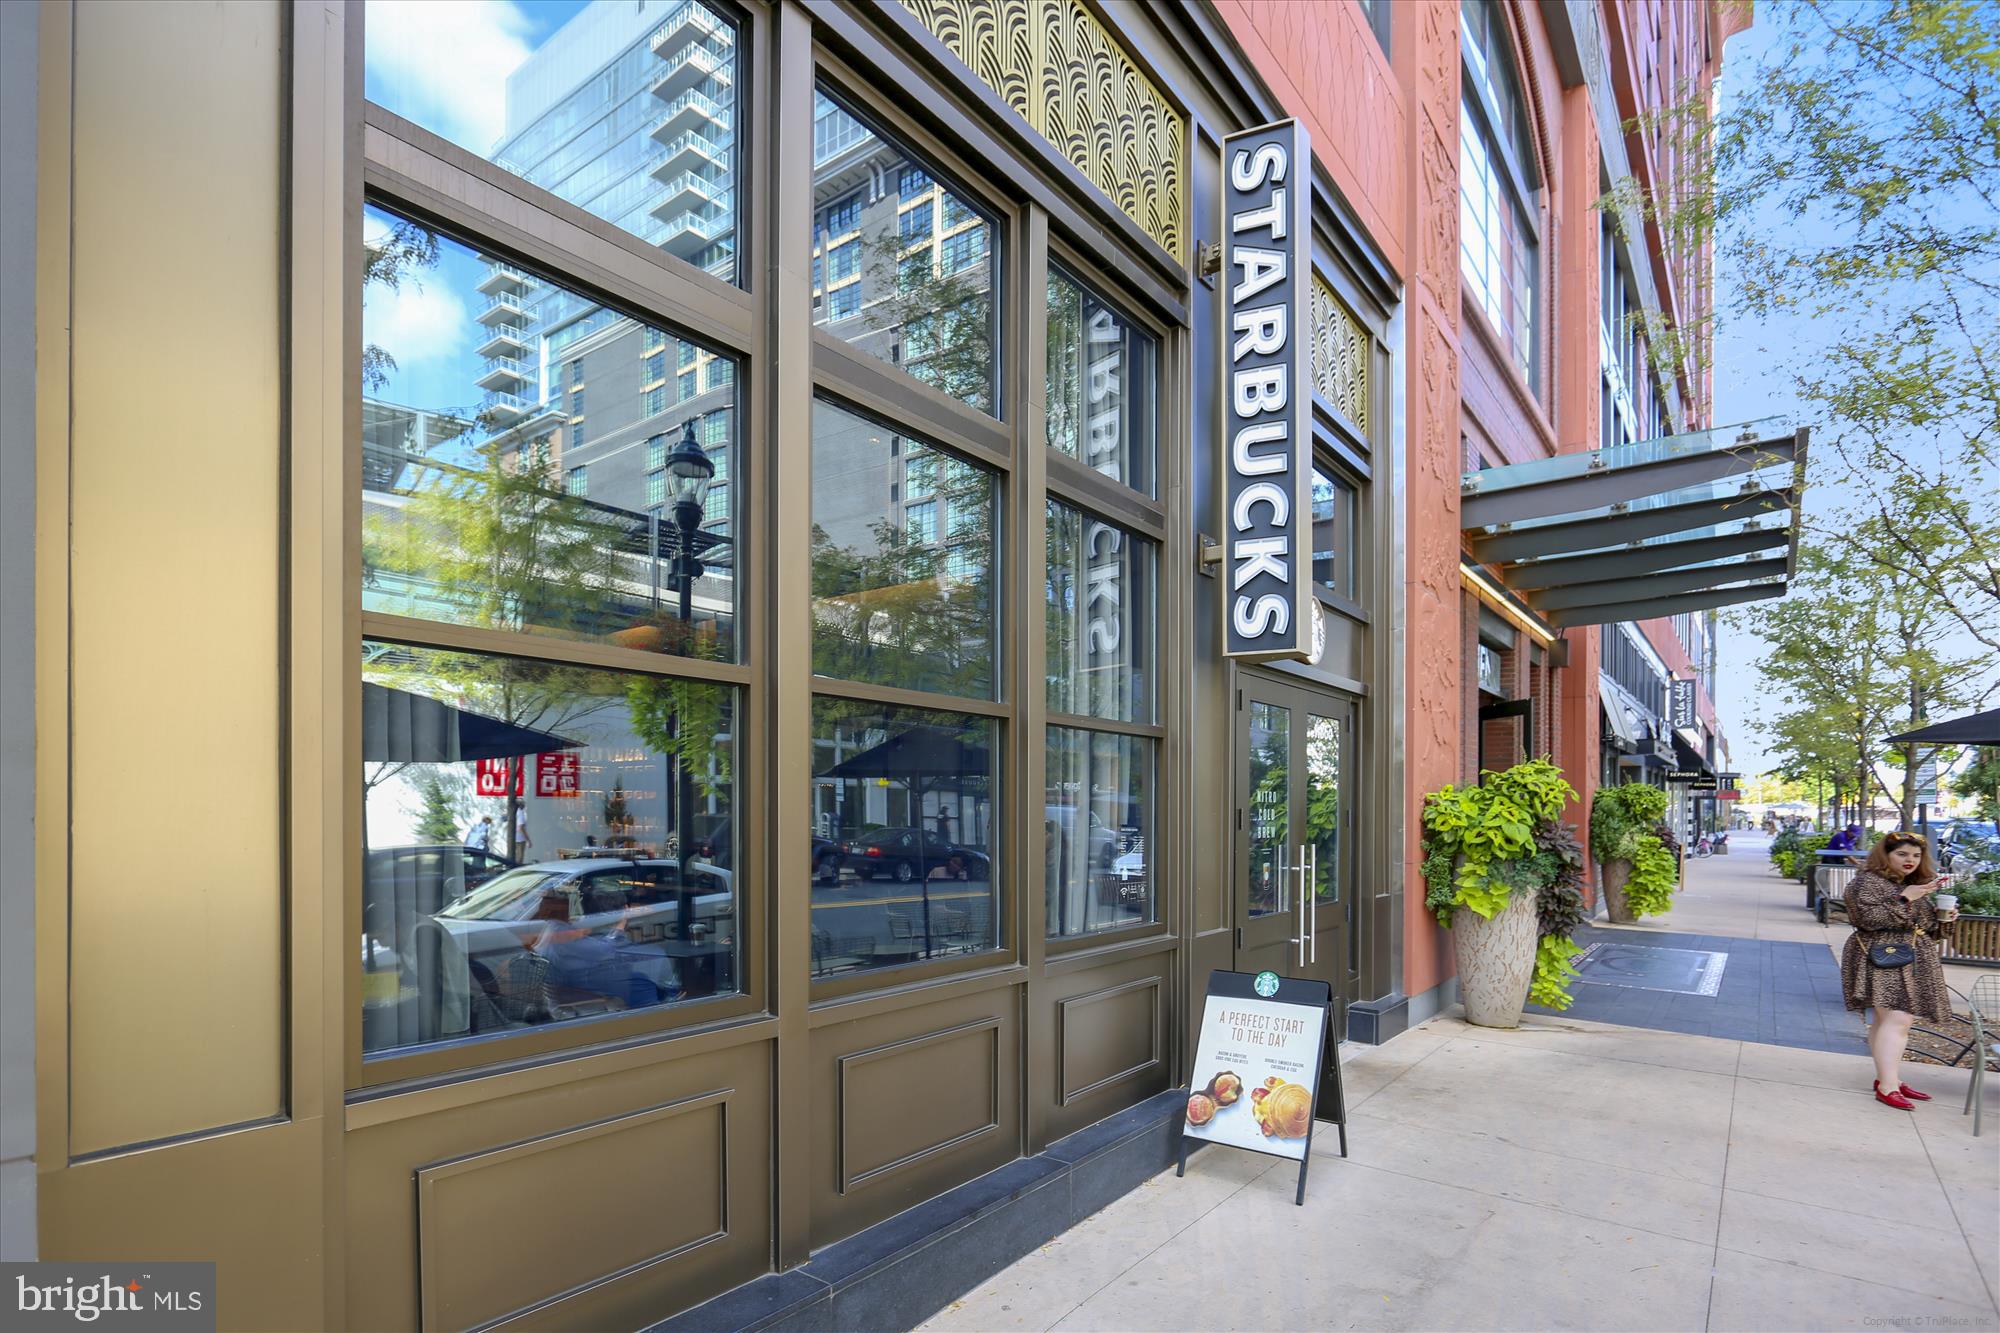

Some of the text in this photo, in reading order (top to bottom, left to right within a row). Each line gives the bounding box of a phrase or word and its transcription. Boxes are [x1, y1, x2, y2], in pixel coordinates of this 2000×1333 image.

[1230, 143, 1290, 639] STARBUCKS
[1257, 790, 1277, 803] NITRO
[1258, 808, 1276, 821] COLD
[1257, 826, 1276, 839] BREW
[1219, 1010, 1305, 1034] A PERFECT START
[1232, 1027, 1288, 1048] TO THE DAY
